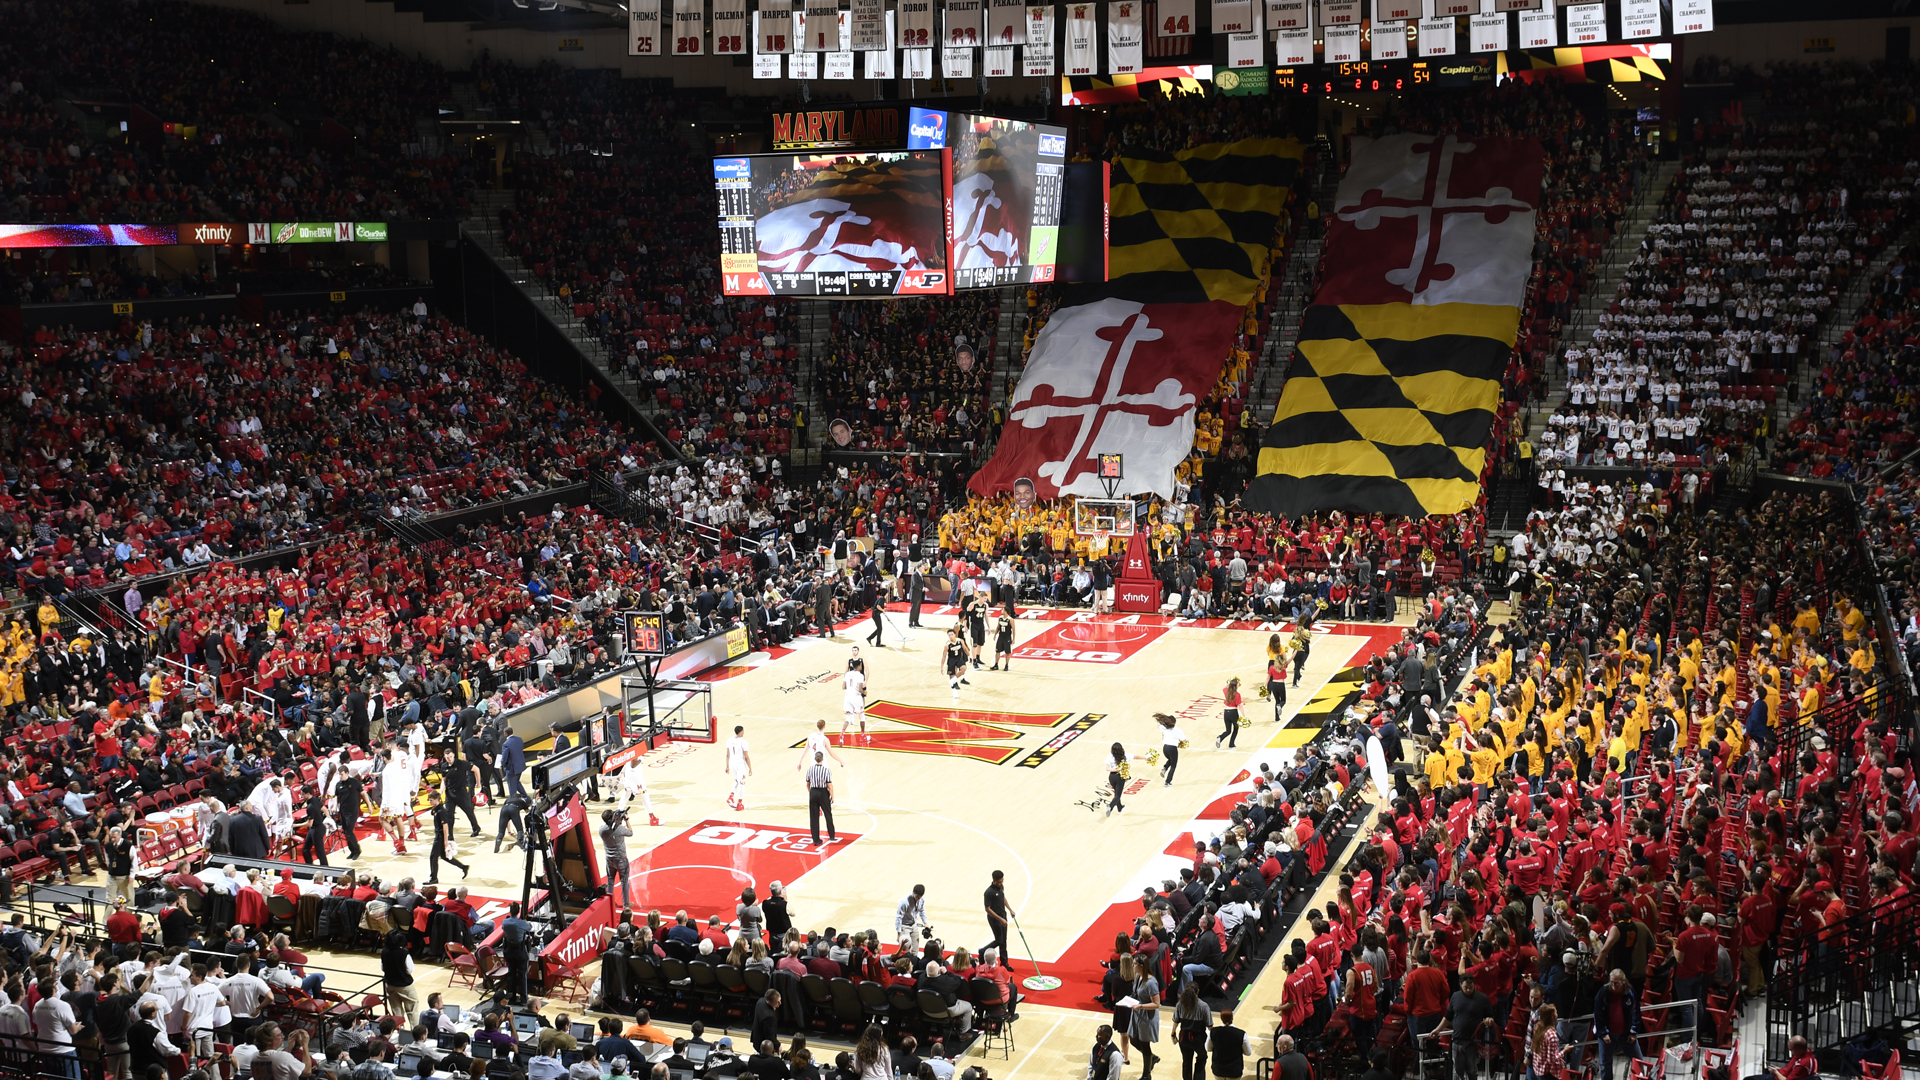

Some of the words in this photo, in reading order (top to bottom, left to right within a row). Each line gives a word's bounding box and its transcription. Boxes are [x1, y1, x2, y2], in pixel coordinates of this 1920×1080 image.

[904, 3, 928, 12] DORON
[949, 2, 979, 11] BULLETT
[1272, 3, 1302, 11] CHAMPIONS
[1448, 6, 1468, 14] 1980
[1508, 0, 1528, 8] 1979
[632, 12, 658, 21] THOMAS
[715, 11, 744, 20] COLEMAN
[762, 10, 790, 19] HARPER
[806, 7, 837, 16] LANGHORNE
[1164, 16, 1189, 34] 44
[904, 28, 928, 46] 22
[952, 28, 976, 45] 23
[1002, 26, 1012, 42] 4
[637, 37, 652, 52] 25
[677, 37, 699, 53] 20
[718, 36, 741, 52] 25
[767, 35, 785, 51] 15
[818, 33, 824, 49] 1
[1340, 62, 1368, 75] 15:49
[1215, 73, 1240, 86] CRA
[1280, 78, 1294, 88] 44
[1414, 71, 1430, 83] 54
[1302, 84, 1308, 93] 2
[1355, 79, 1362, 88] 2
[1372, 80, 1379, 90] 0
[1396, 79, 1402, 89] 2
[772, 109, 898, 142] MARYLAND
[195, 224, 232, 243] xfinity
[254, 224, 266, 240] M
[340, 224, 350, 239] M
[974, 267, 994, 283] 15:49
[1036, 268, 1044, 280] 54
[1044, 268, 1053, 280] P
[725, 274, 740, 290] M
[747, 278, 763, 288] 44
[776, 280, 782, 289] 2
[819, 276, 846, 286] 15:49
[904, 276, 920, 288] 54
[920, 273, 944, 288] P
[116, 304, 129, 312] 126
[1103, 463, 1118, 476] 30
[1122, 593, 1150, 603] xfinity
[634, 616, 660, 628] 15:49
[636, 630, 658, 650] 30
[1124, 778, 1151, 794] COURT
[558, 818, 573, 829] TOYOTA
[1640, 906, 1648, 920] 11
[558, 924, 603, 962] xfinity
[1361, 970, 1373, 986] 15
